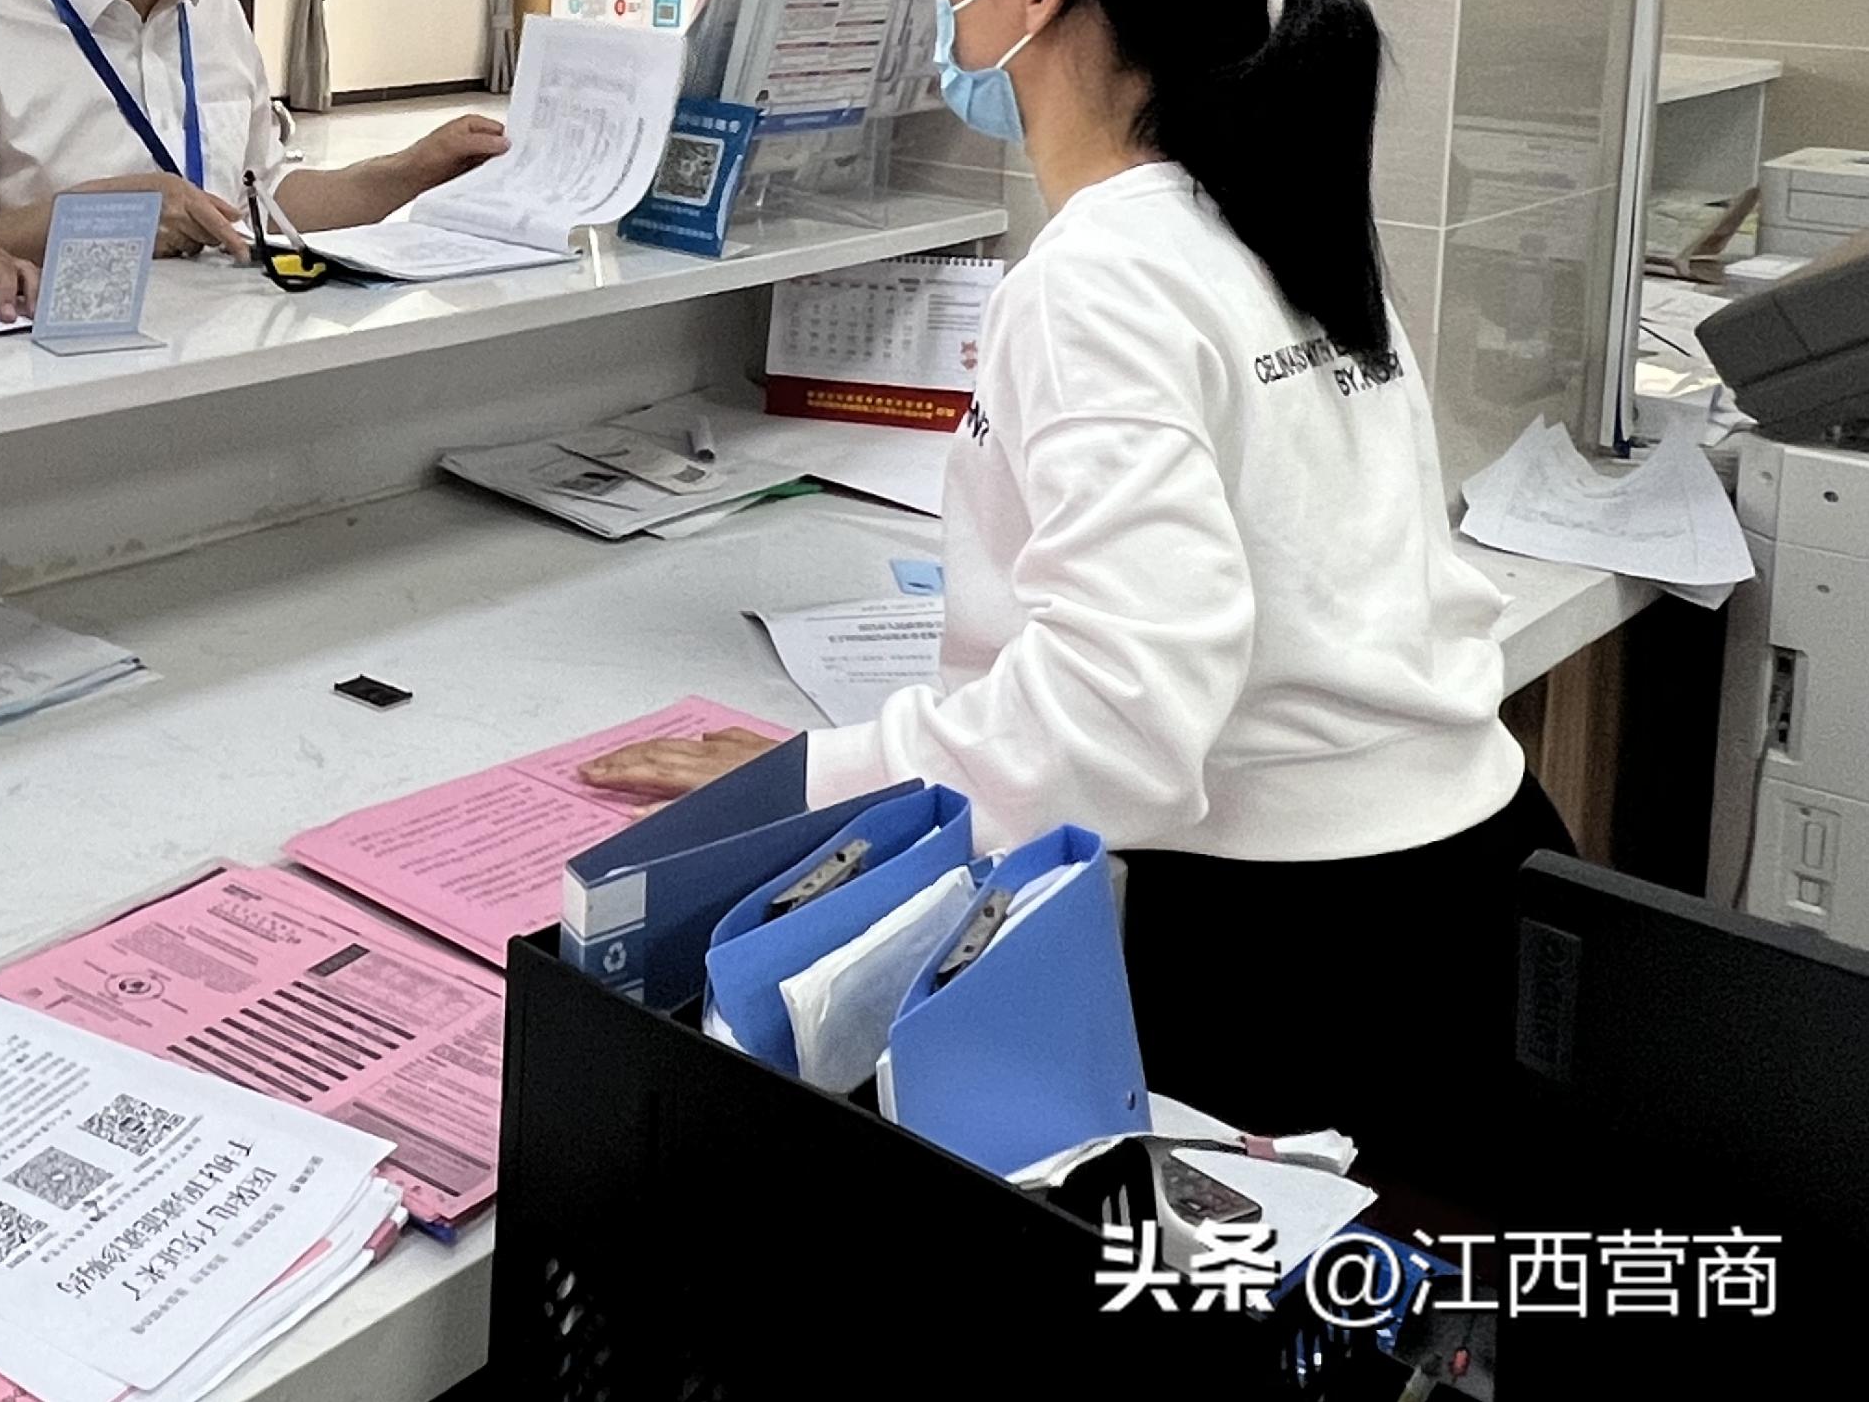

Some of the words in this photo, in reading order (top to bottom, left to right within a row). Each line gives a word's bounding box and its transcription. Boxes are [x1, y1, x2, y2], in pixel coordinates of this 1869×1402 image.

[113, 1165, 283, 1304] 医保电子凭证来了
